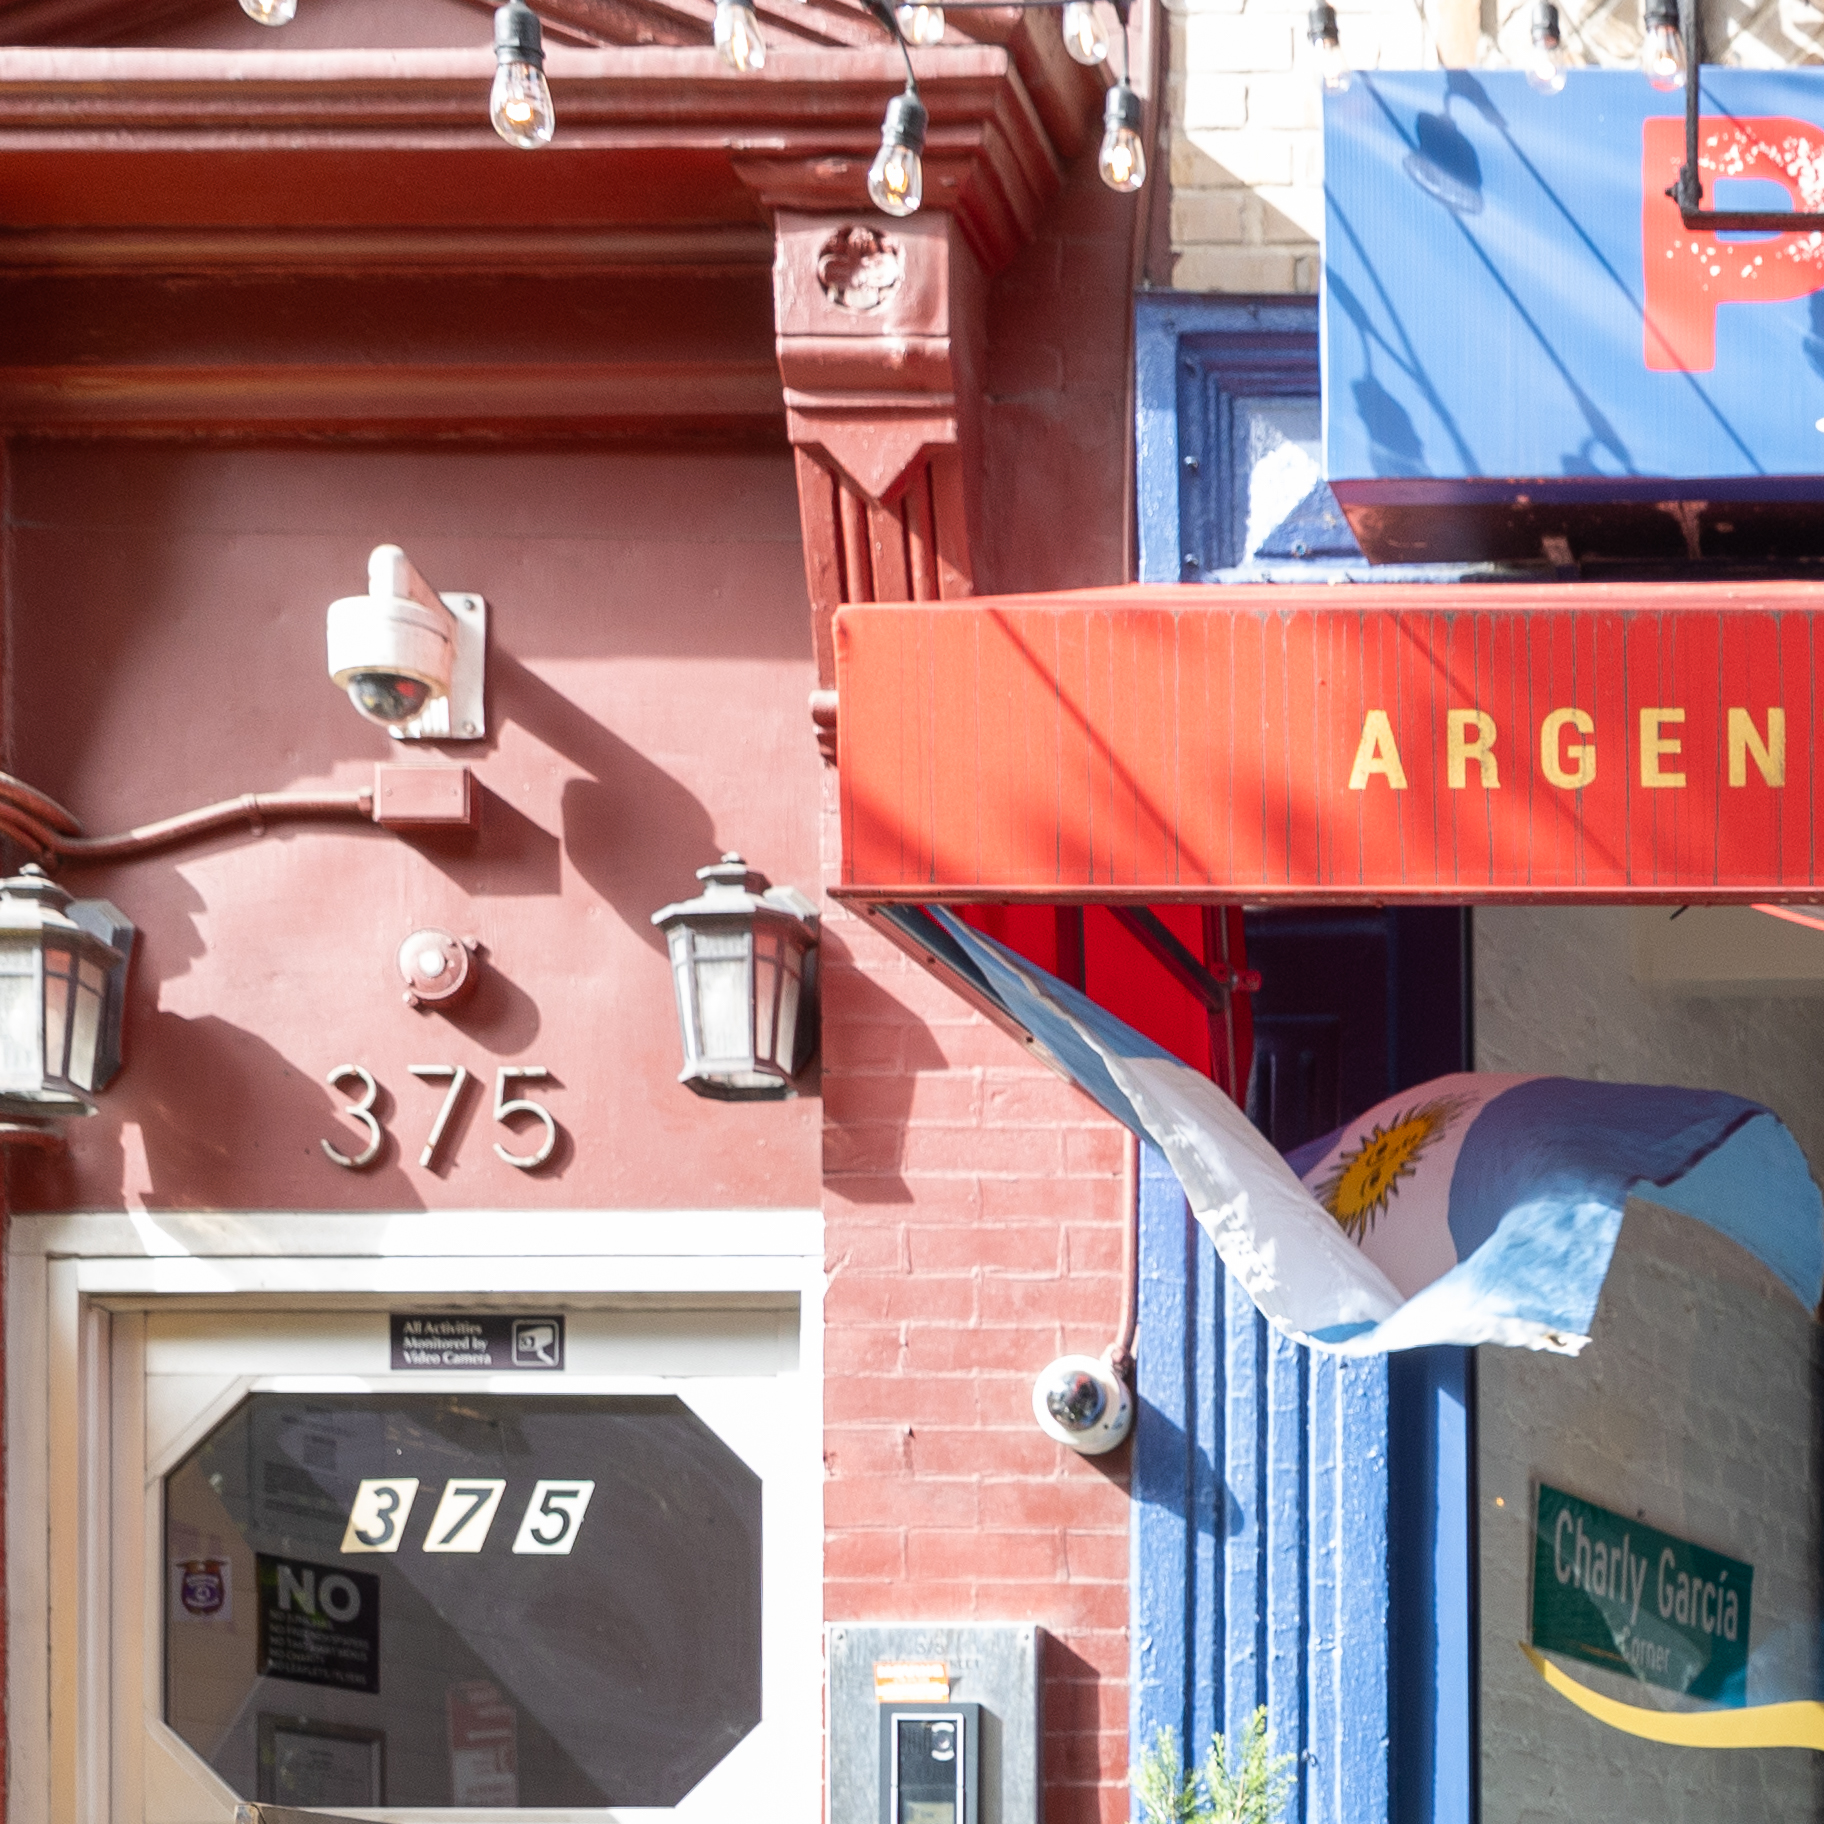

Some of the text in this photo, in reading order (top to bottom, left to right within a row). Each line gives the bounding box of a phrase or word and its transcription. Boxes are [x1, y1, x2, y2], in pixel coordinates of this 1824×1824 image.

[320, 1064, 560, 1169] 375
[403, 1321, 483, 1335] All Activities
[403, 1336, 488, 1352] Monitored by
[403, 1351, 492, 1365] Video Camera
[354, 1486, 580, 1546] 375
[276, 1563, 361, 1622] NO
[1554, 1507, 1739, 1642] Charly García
